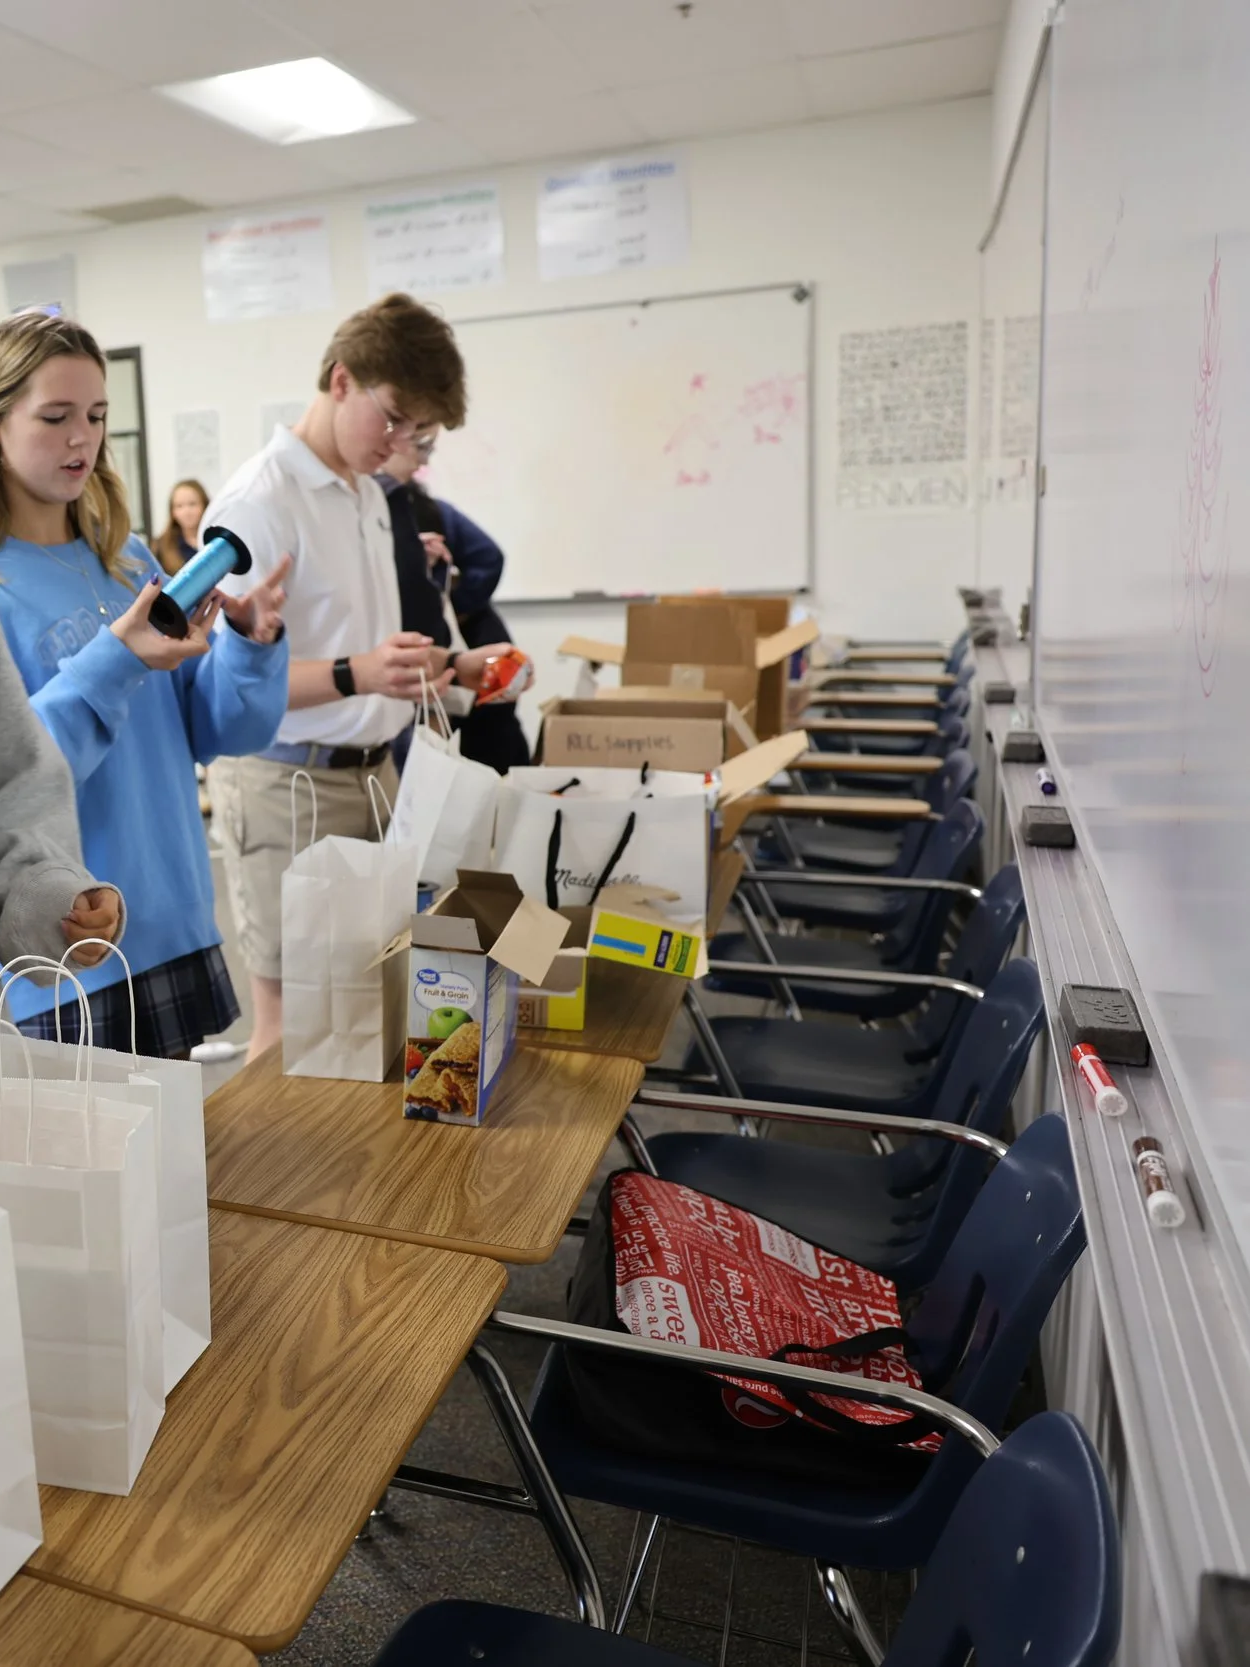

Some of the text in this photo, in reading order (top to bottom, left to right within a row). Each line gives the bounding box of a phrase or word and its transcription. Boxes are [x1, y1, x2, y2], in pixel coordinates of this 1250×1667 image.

[424, 988, 439, 996] Fruit
[447, 991, 469, 999] Grain
[614, 1195, 637, 1218] there
[635, 1204, 672, 1249] practice
[662, 1250, 683, 1276] life.
[640, 1281, 656, 1312] once
[720, 1263, 759, 1348] jealousy
[647, 1316, 658, 1324] a
[745, 1381, 768, 1392] pure
